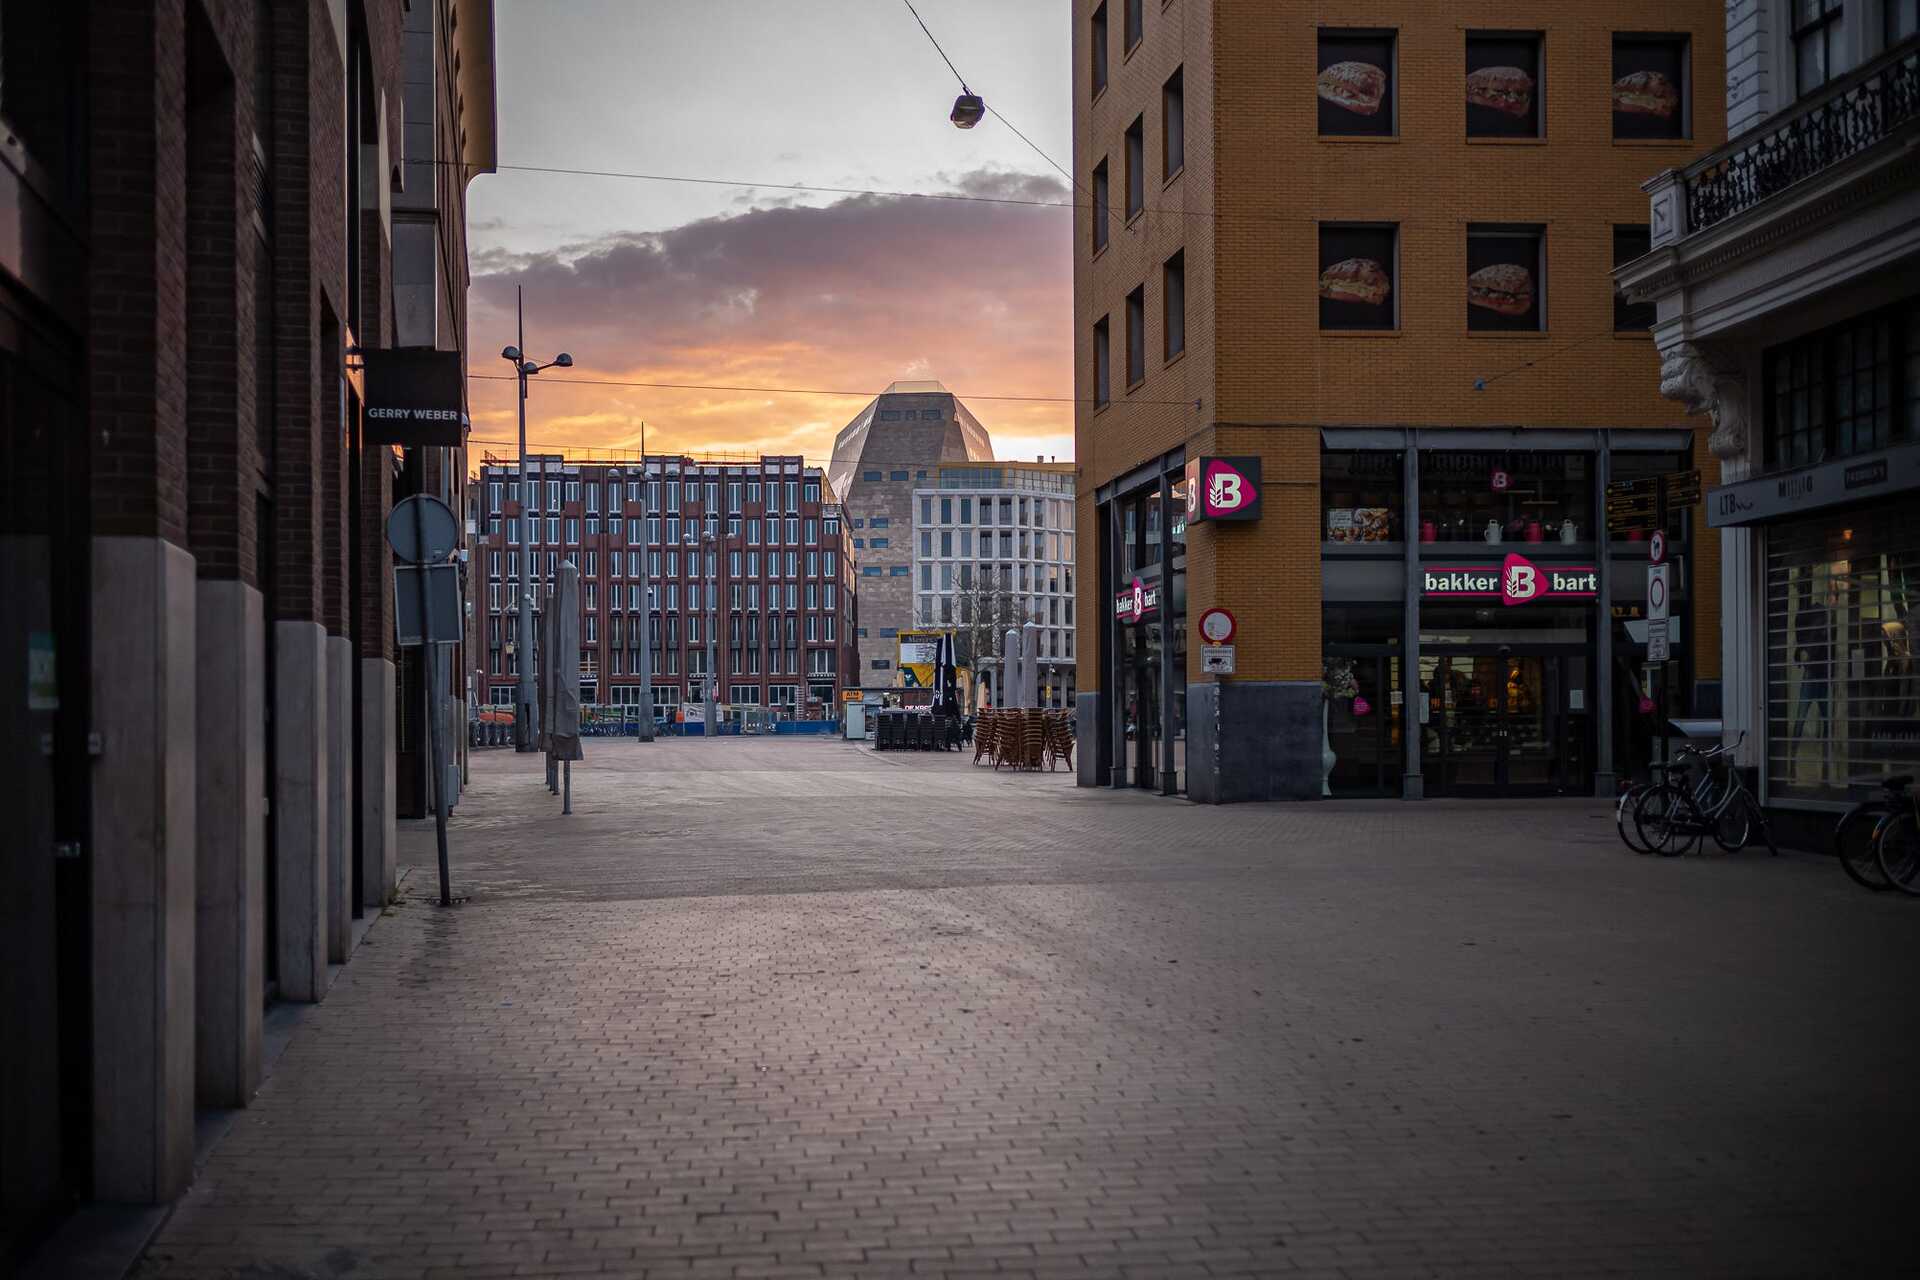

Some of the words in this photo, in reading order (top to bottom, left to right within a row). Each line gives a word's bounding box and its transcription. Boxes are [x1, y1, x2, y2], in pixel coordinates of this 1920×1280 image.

[367, 407, 411, 420] GERRY
[413, 409, 458, 420] WEBER
[1210, 473, 1243, 508] B
[1424, 572, 1498, 591] bakker
[1508, 565, 1536, 598] B
[1552, 572, 1597, 591] bart
[1116, 593, 1134, 614] bakker
[1144, 589, 1157, 607] bart
